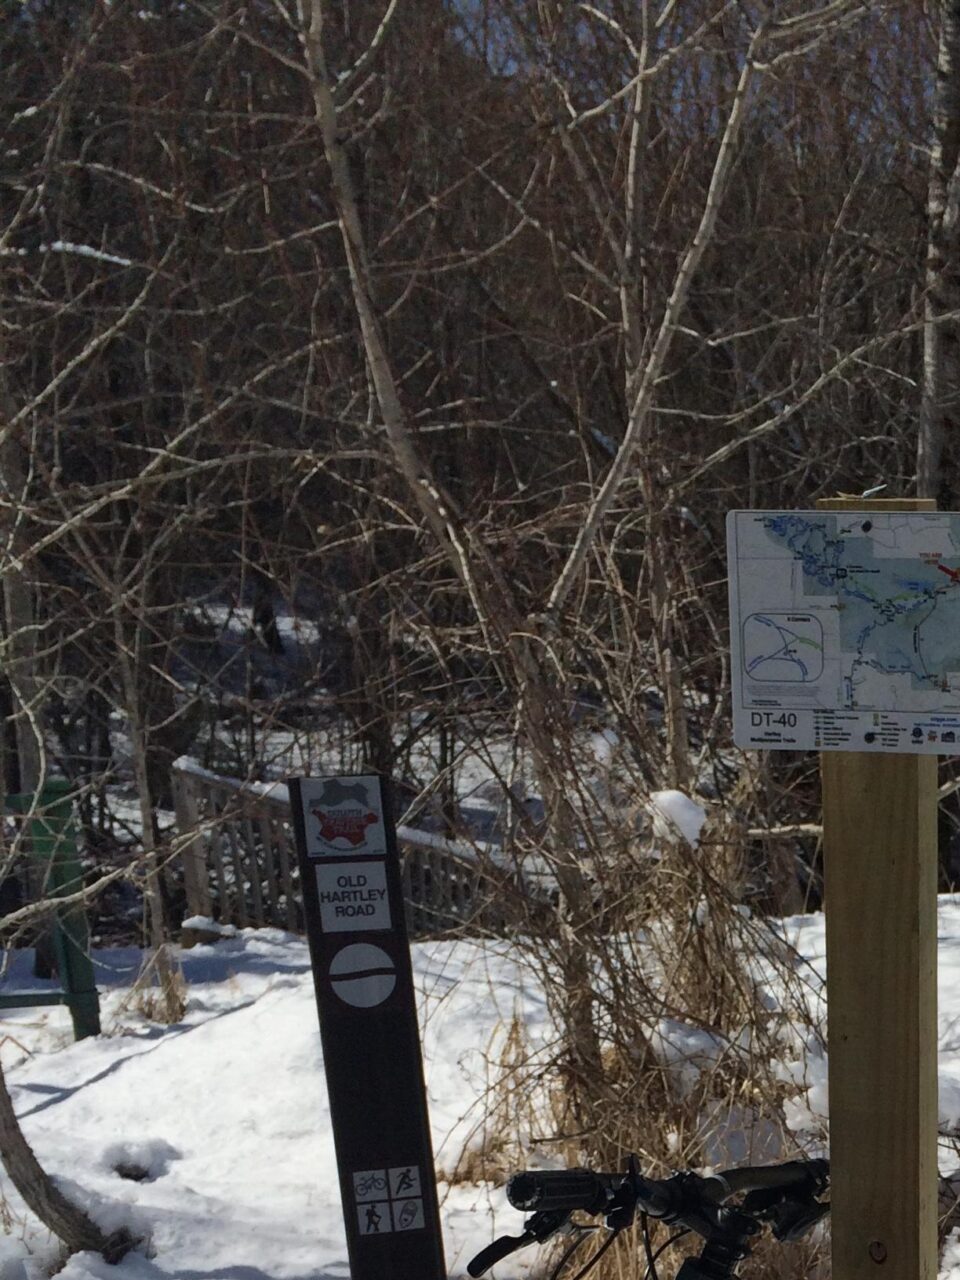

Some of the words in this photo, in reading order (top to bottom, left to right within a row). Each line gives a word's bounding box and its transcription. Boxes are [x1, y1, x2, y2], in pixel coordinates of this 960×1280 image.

[751, 711, 798, 728] DT-40
[337, 874, 367, 888] OLD
[320, 888, 386, 903] HARTLEY
[335, 904, 375, 917] ROAD
